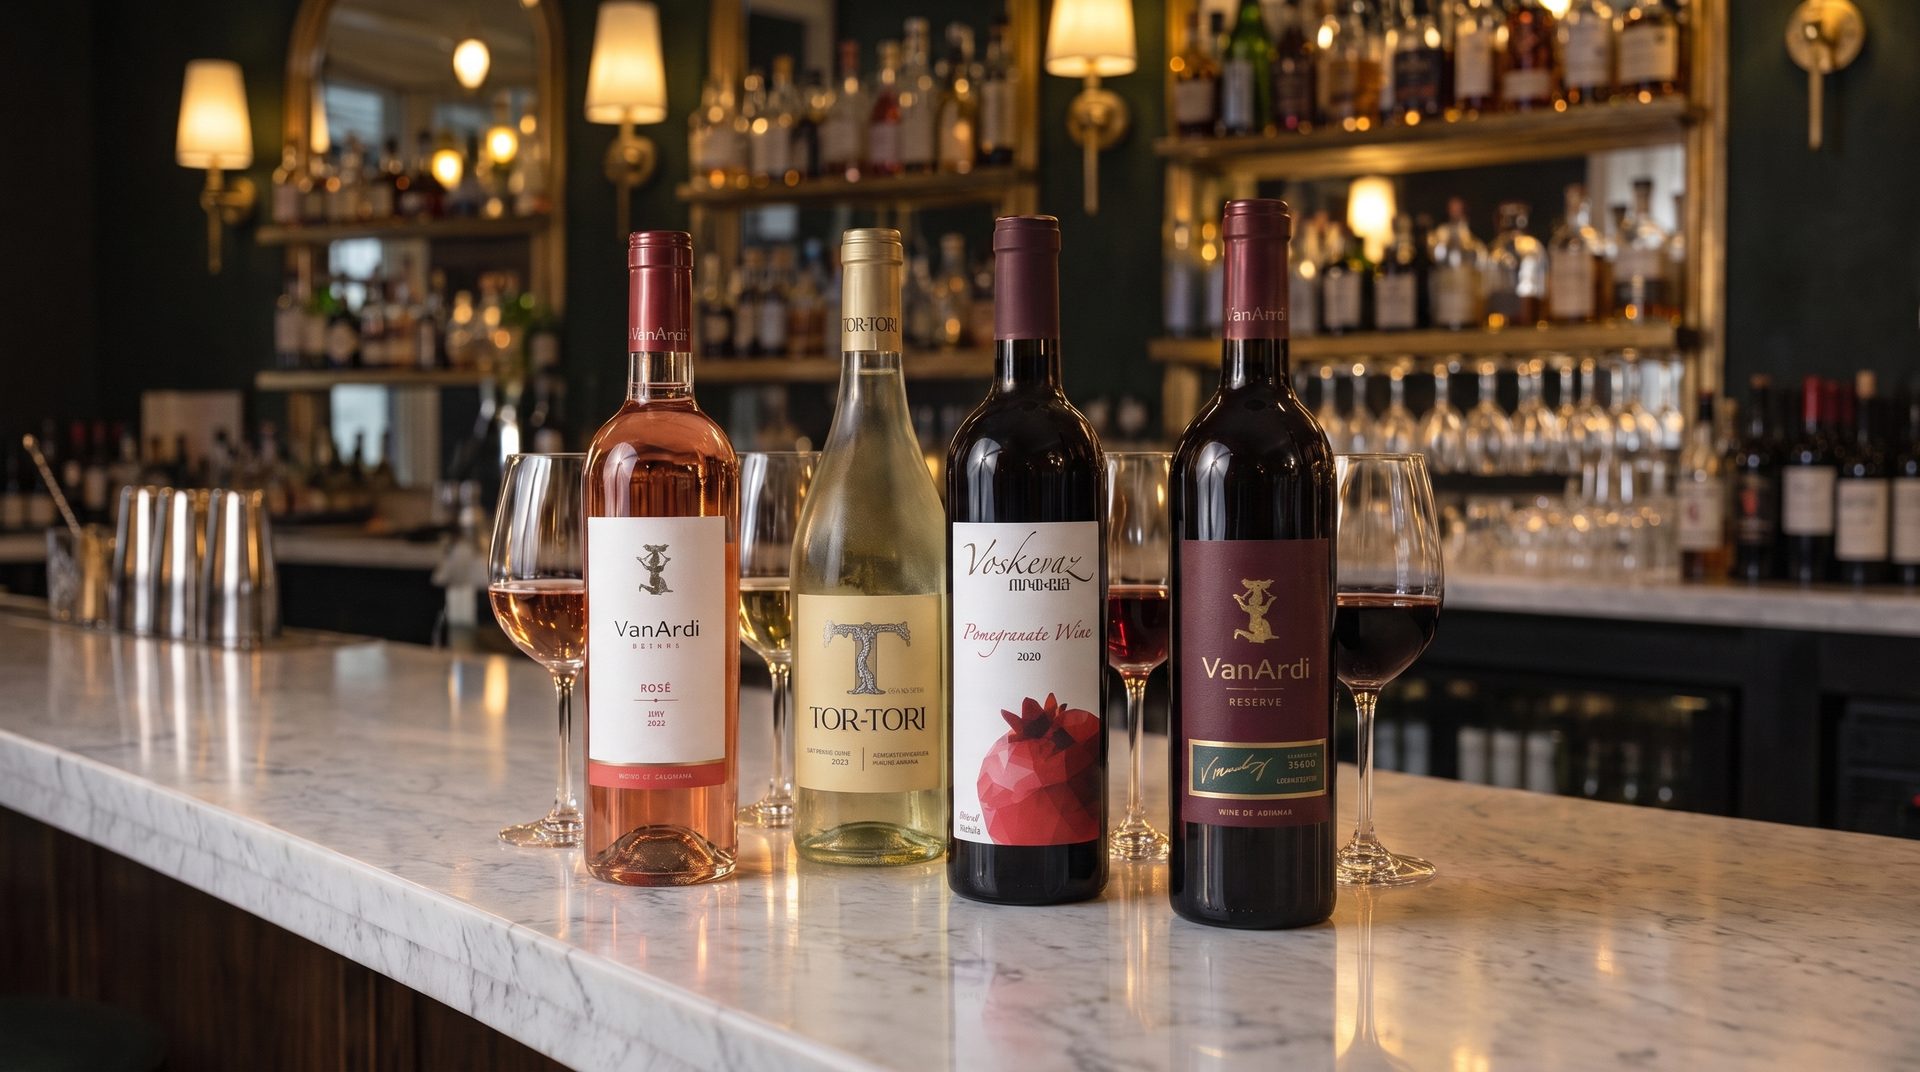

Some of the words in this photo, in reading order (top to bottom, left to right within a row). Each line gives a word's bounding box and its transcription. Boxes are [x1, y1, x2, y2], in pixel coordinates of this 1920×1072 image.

[843, 316, 898, 333] TOR-TORI
[963, 530, 1094, 583] Voskevaz
[614, 619, 700, 638] VanArdi
[963, 622, 1051, 658] Pomegranate
[1055, 619, 1094, 641] Wine
[1017, 651, 1042, 662] 2020
[1201, 656, 1310, 680] VanArdi
[1229, 698, 1282, 707] RESERVE
[647, 719, 666, 727] 2022
[809, 706, 926, 731] TOR-TORI
[831, 758, 849, 766] 2023
[1288, 759, 1316, 769] 35600
[1218, 808, 1240, 816] WINE
